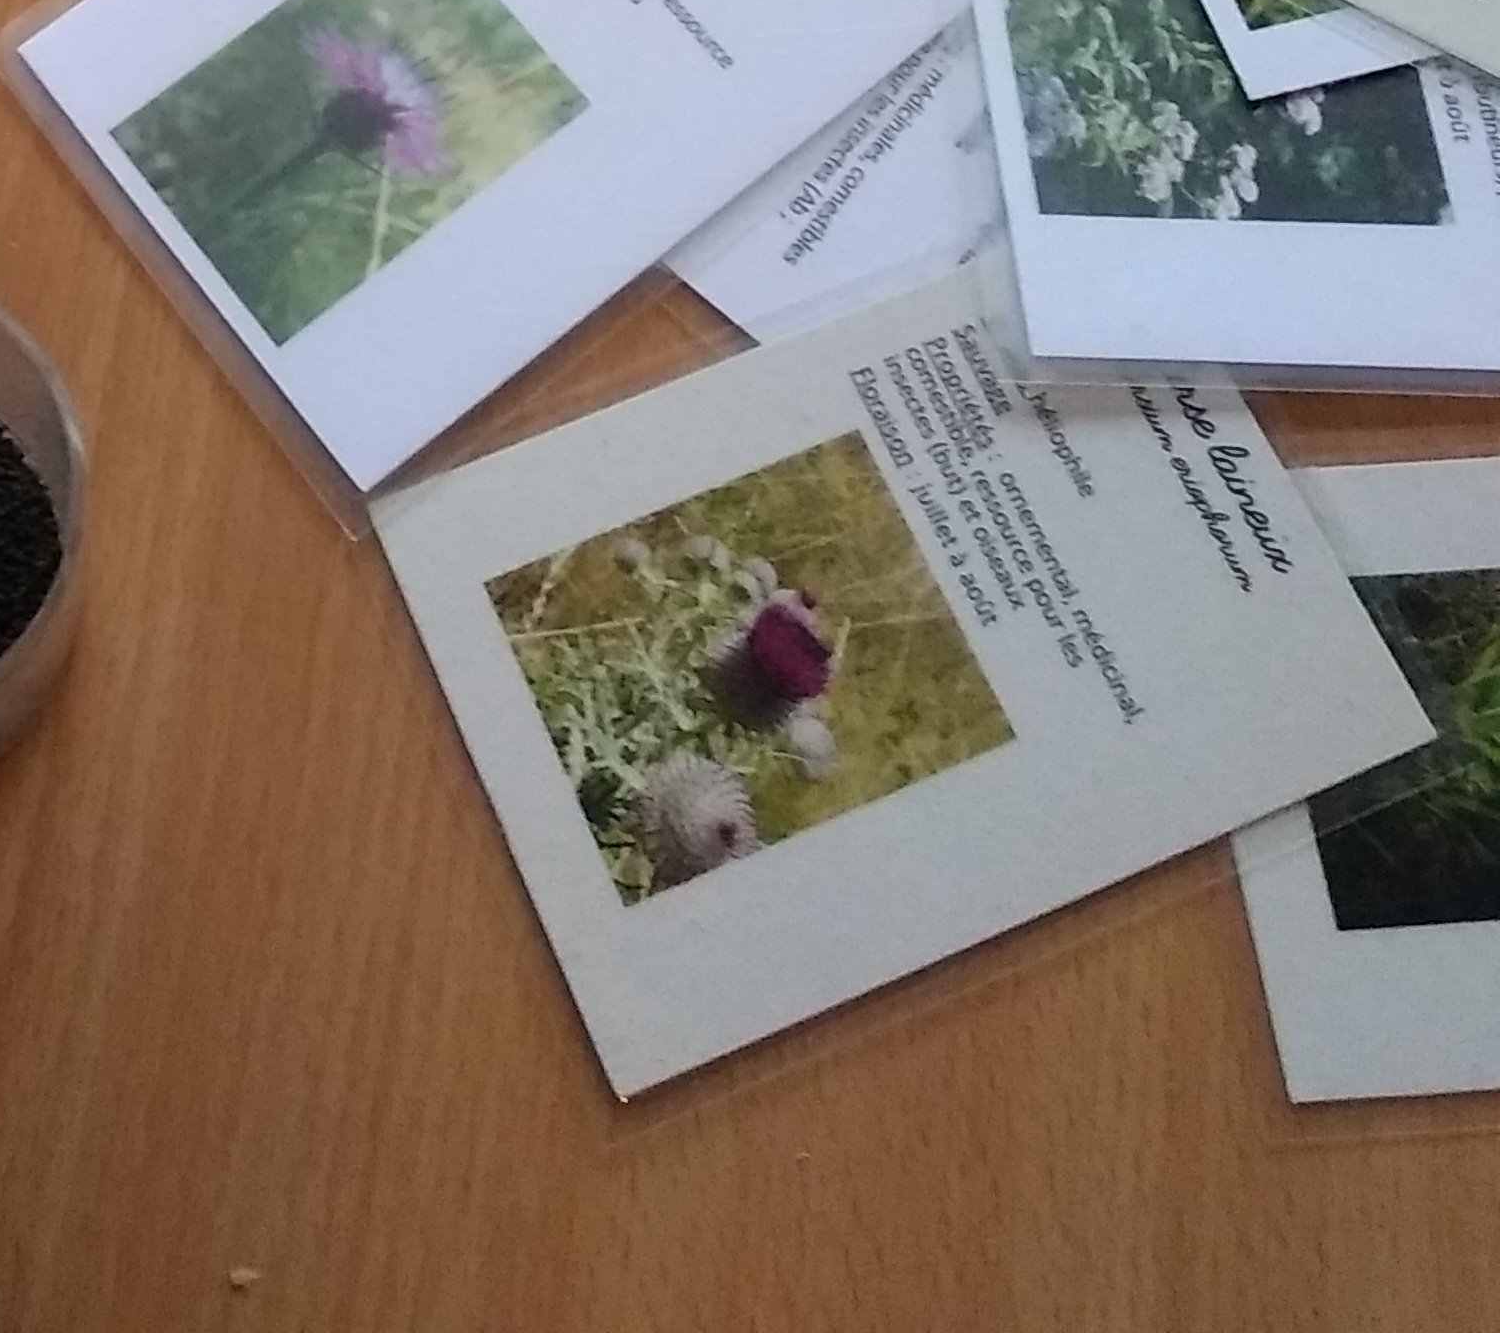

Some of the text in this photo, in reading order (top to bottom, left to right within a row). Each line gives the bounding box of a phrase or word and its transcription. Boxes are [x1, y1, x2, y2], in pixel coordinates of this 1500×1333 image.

[812, 117, 876, 184] insectes
[857, 68, 943, 163] médicinales,
[866, 91, 897, 118] les
[783, 166, 864, 265] comestibles
[789, 181, 824, 215] (Ab
[848, 366, 914, 469] Floraison
[950, 324, 1013, 417] Sauvage
[883, 354, 1026, 611] insectes (but) et oiseaux
[1026, 391, 1095, 498] héliophile
[1129, 386, 1252, 593] rsium eriophorum
[1172, 387, 1293, 574] rse laineux
[905, 347, 1084, 668] comestible, ressource pour les
[907, 483, 958, 549] juillet
[921, 336, 995, 451] Propriétés
[999, 472, 1080, 606] ornemental,
[1071, 609, 1145, 725] médicinal,
[949, 553, 968, 568] à
[958, 573, 997, 627] août
